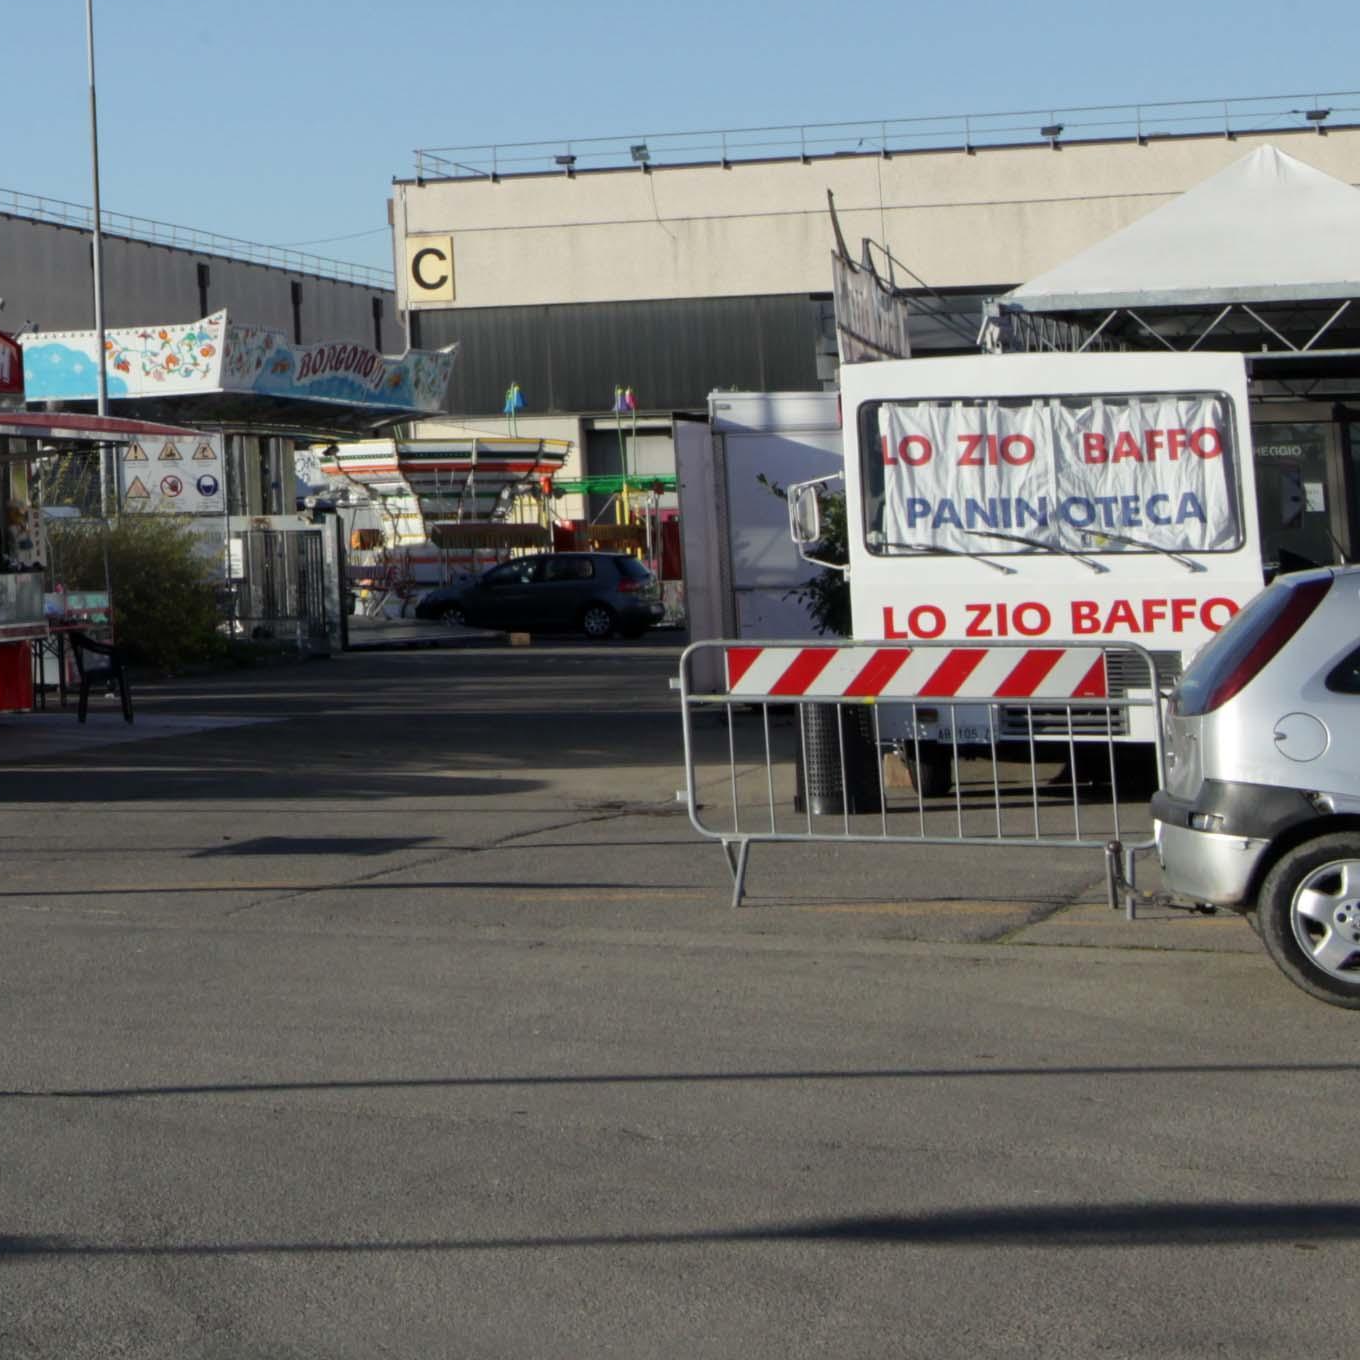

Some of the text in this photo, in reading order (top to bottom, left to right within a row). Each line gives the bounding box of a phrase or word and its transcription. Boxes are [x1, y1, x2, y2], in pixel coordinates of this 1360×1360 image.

[412, 248, 448, 290] C
[882, 427, 1223, 466] LO ZIO BAFFO
[905, 491, 1208, 529] PANINOTECA
[882, 597, 1240, 640] LO ZIO BAFFO
